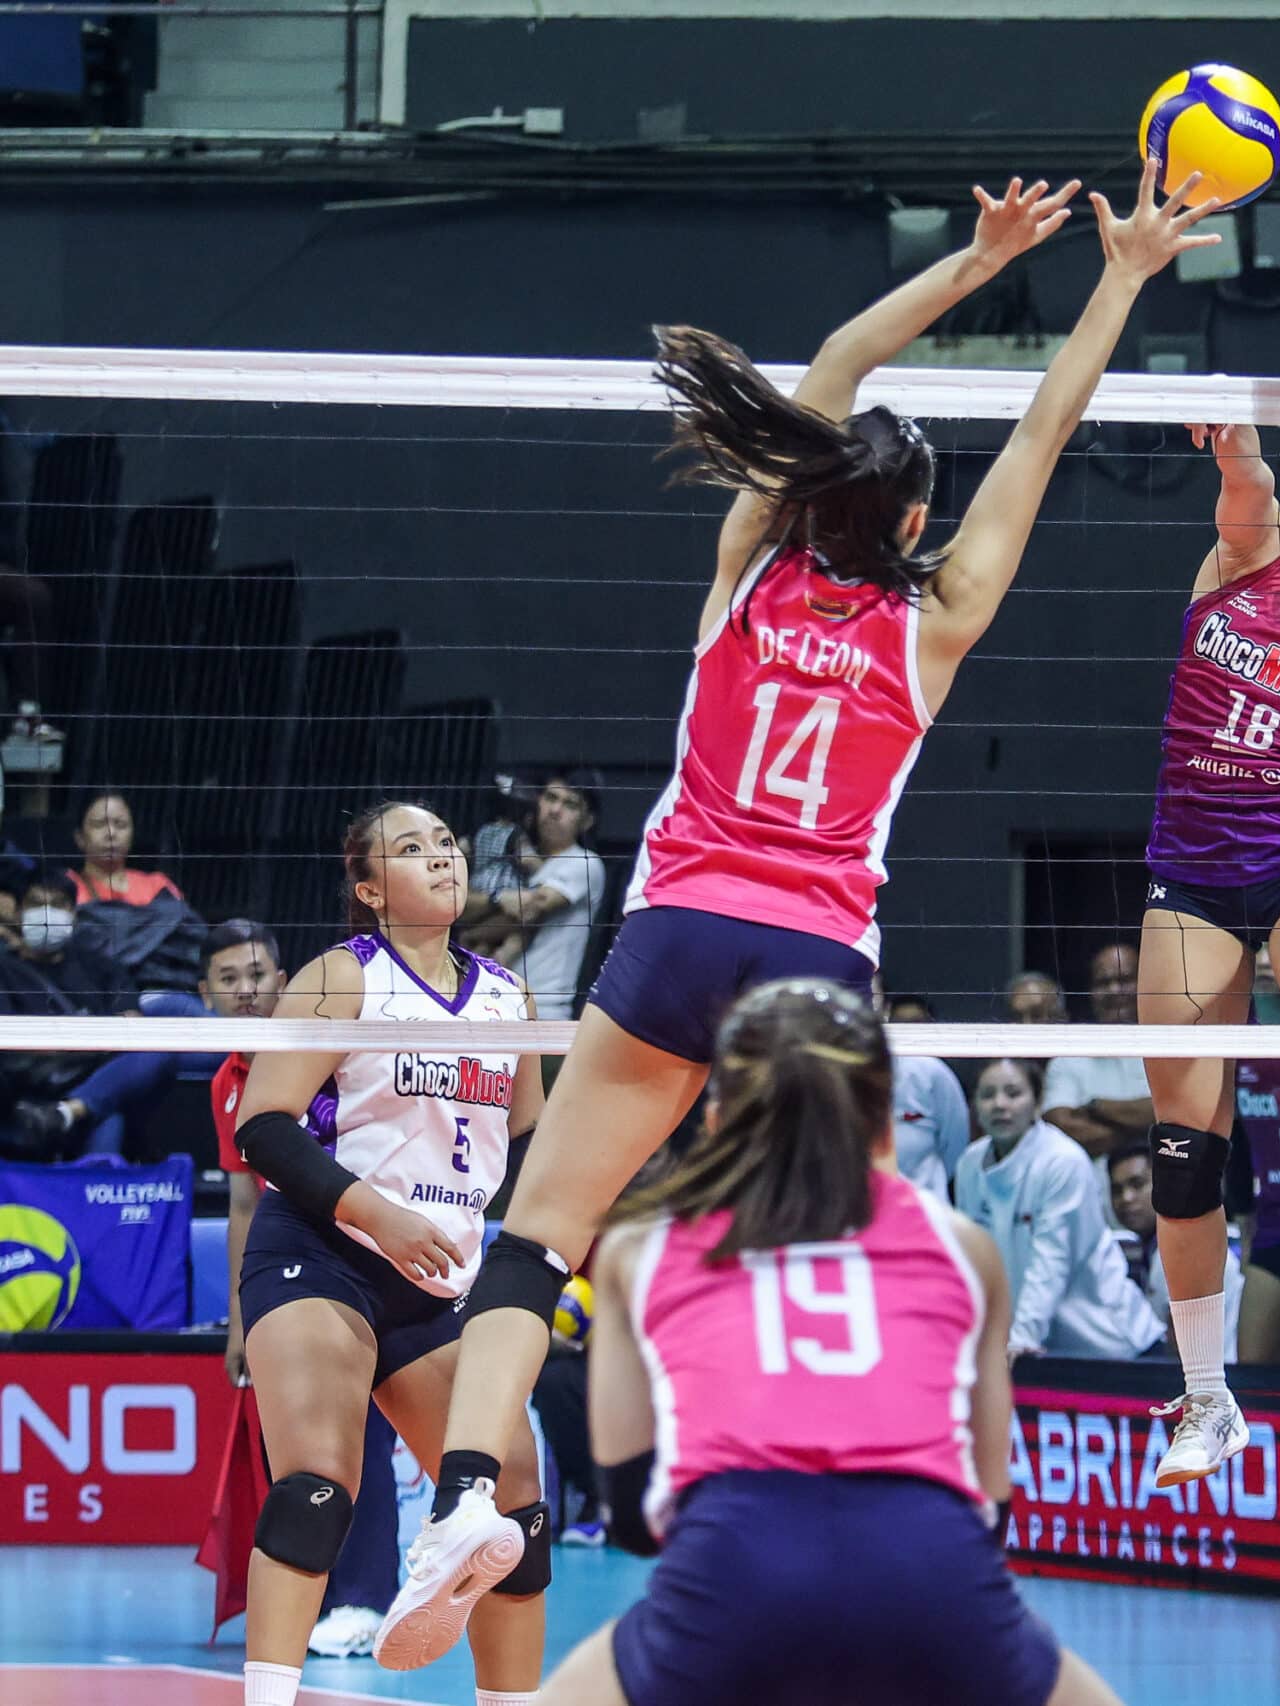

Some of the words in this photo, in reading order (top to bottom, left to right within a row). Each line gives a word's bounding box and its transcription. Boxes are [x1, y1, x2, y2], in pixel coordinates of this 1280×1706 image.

[757, 625, 797, 665] DE
[796, 632, 871, 690] LEON
[735, 682, 842, 830] 14
[1186, 755, 1256, 779] Allianz
[394, 1052, 513, 1109] ChocoMuch
[451, 1116, 472, 1174] 5
[85, 1181, 184, 1204] VOLLEYBALL
[410, 1183, 475, 1210] Allian
[740, 1240, 884, 1377] 19
[1008, 1408, 1278, 1520] ABRIAO
[1005, 1513, 1237, 1571] APPLIANCES
